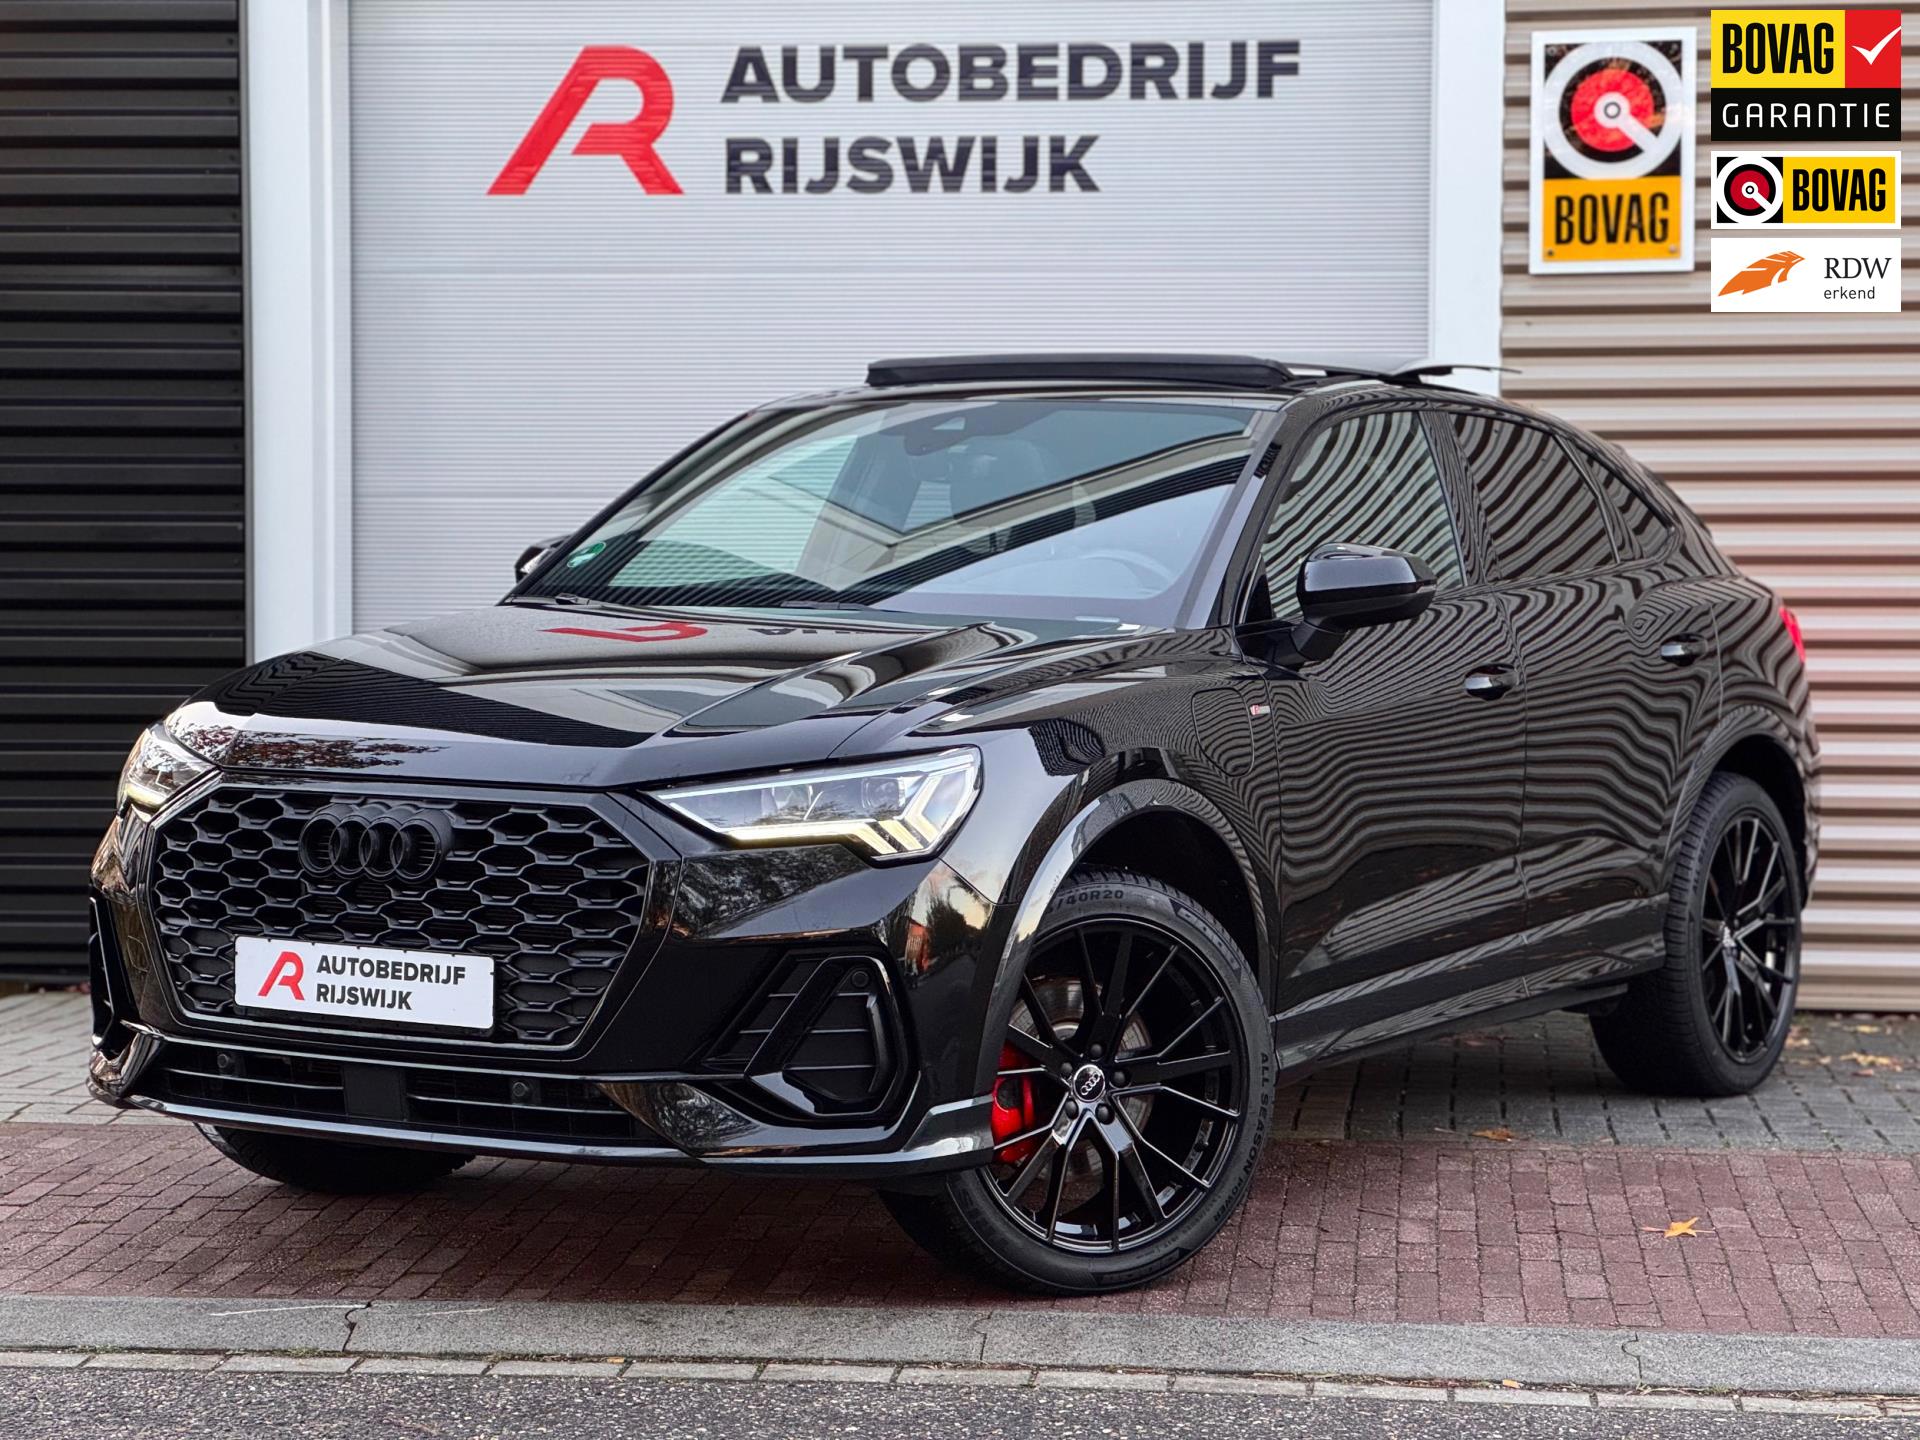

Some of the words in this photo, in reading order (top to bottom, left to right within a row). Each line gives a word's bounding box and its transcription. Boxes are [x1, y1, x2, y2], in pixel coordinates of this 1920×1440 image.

[720, 40, 1301, 104] AUTOBEDRIJF
[725, 135, 1101, 194] RIJSWIJK
[1554, 192, 1669, 245] BOVAG
[316, 955, 466, 985] AUTOBEDRIJF
[316, 984, 412, 1010] RIJSWIJK
[1260, 1052, 1269, 1087] ALL
[1243, 1093, 1269, 1174] SEASON
